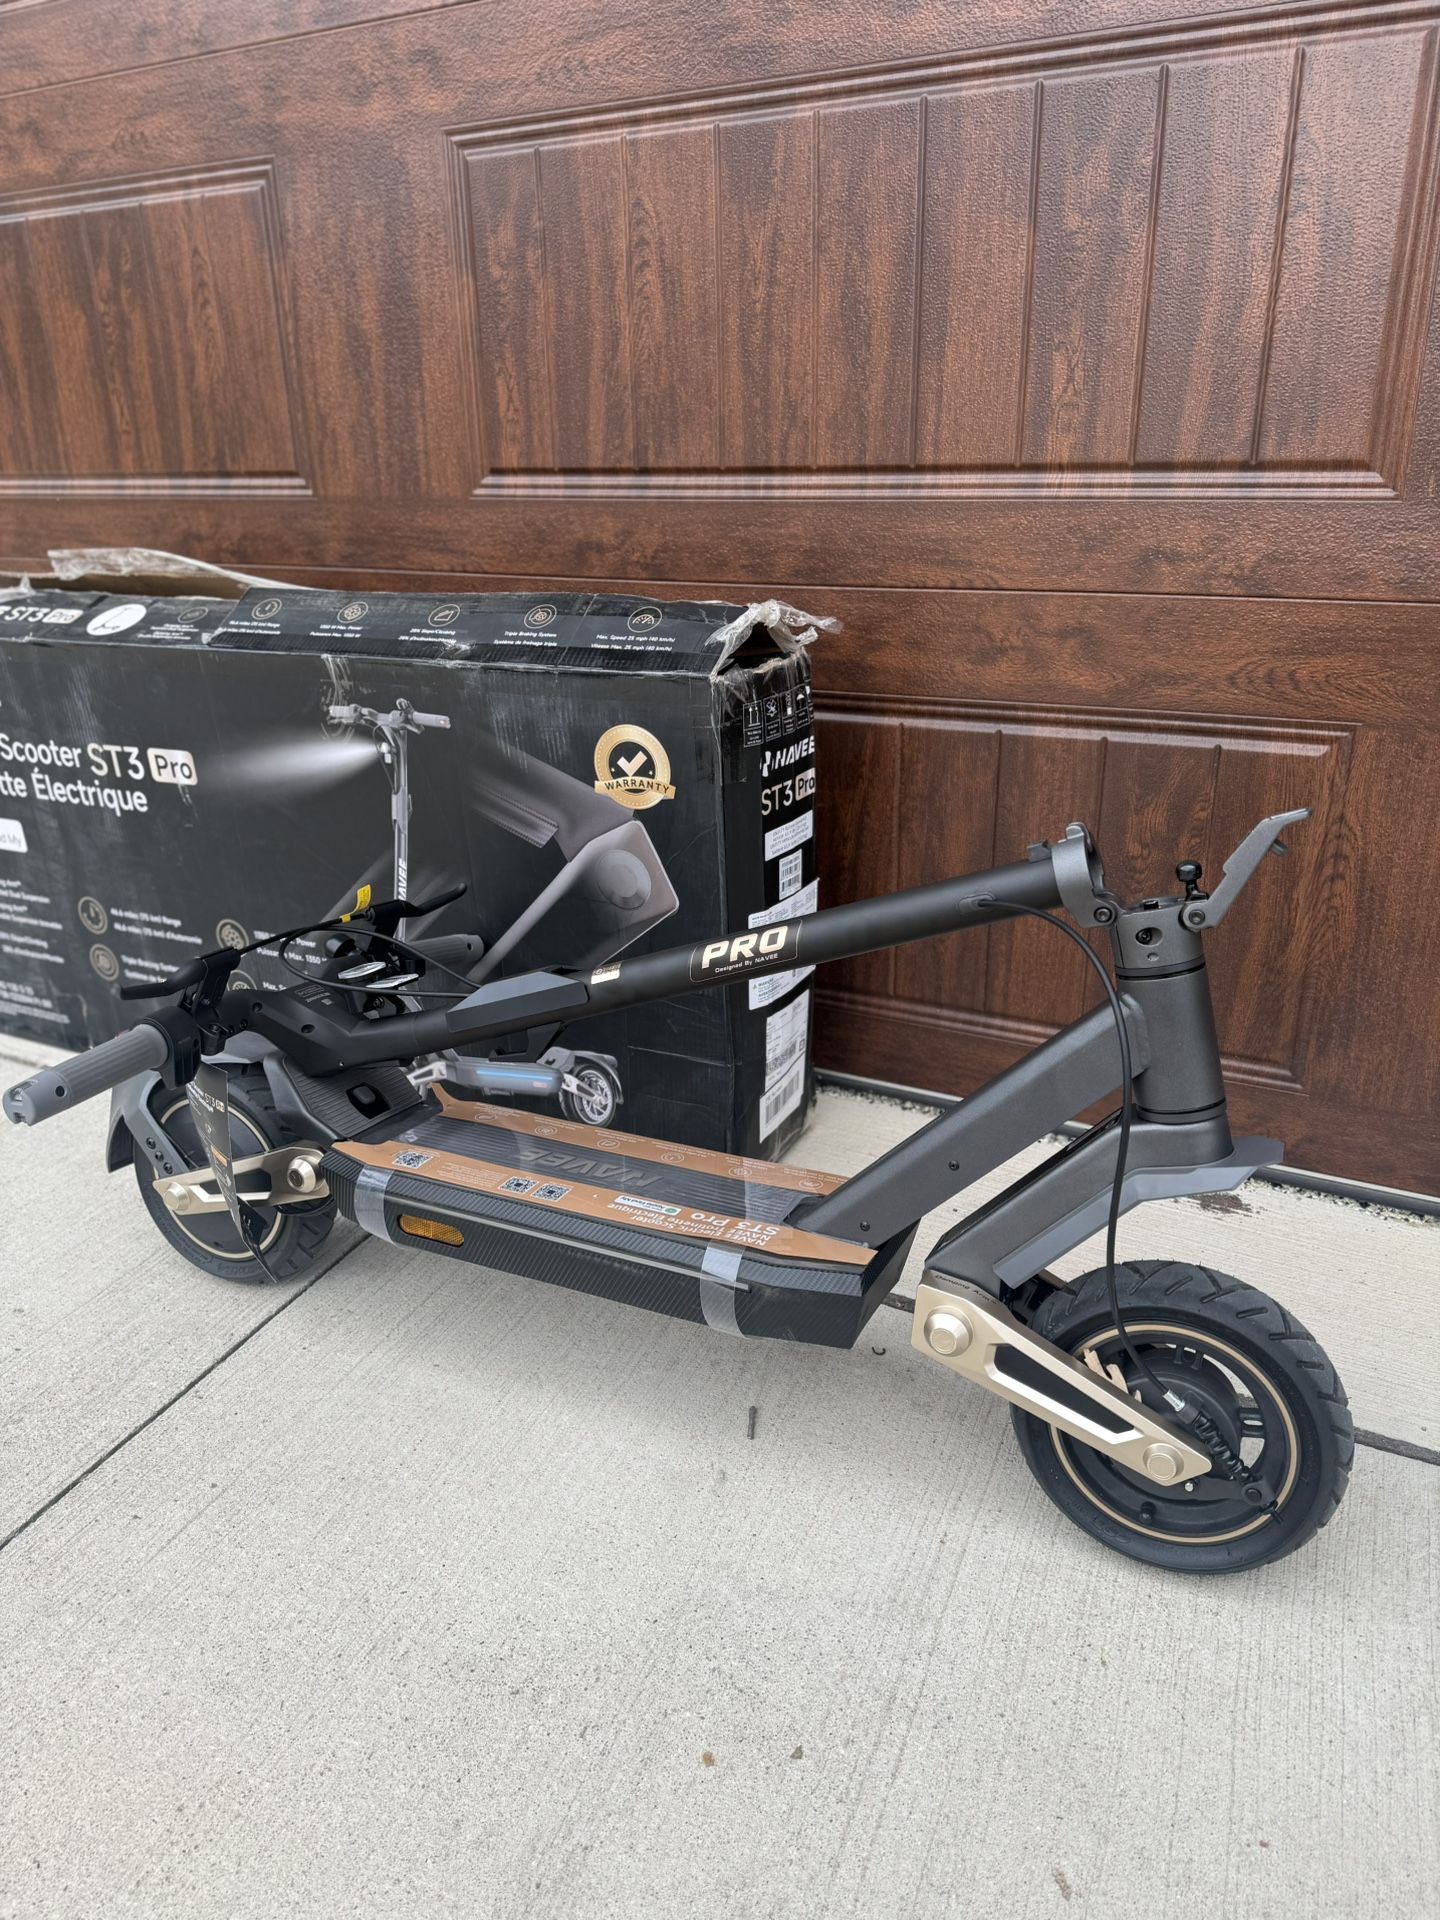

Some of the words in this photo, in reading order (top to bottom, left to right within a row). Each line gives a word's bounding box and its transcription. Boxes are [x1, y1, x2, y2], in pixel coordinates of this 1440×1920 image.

[4, 606, 51, 623] ST3
[0, 733, 82, 768] Scooter
[88, 743, 145, 781] ST3
[155, 755, 193, 780] Pro
[774, 735, 815, 770] NAVEE
[31, 766, 149, 818] Électrique
[604, 778, 670, 795] WARRANTY
[761, 779, 794, 816] ST3
[798, 776, 815, 799] Pro
[702, 926, 788, 969] PRO
[715, 961, 743, 974] Designed
[744, 959, 753, 967] By
[754, 953, 778, 964] NAVEE
[513, 1149, 665, 1188] NAVEE
[690, 1212, 730, 1227] Pro
[733, 1221, 780, 1235] ST3
